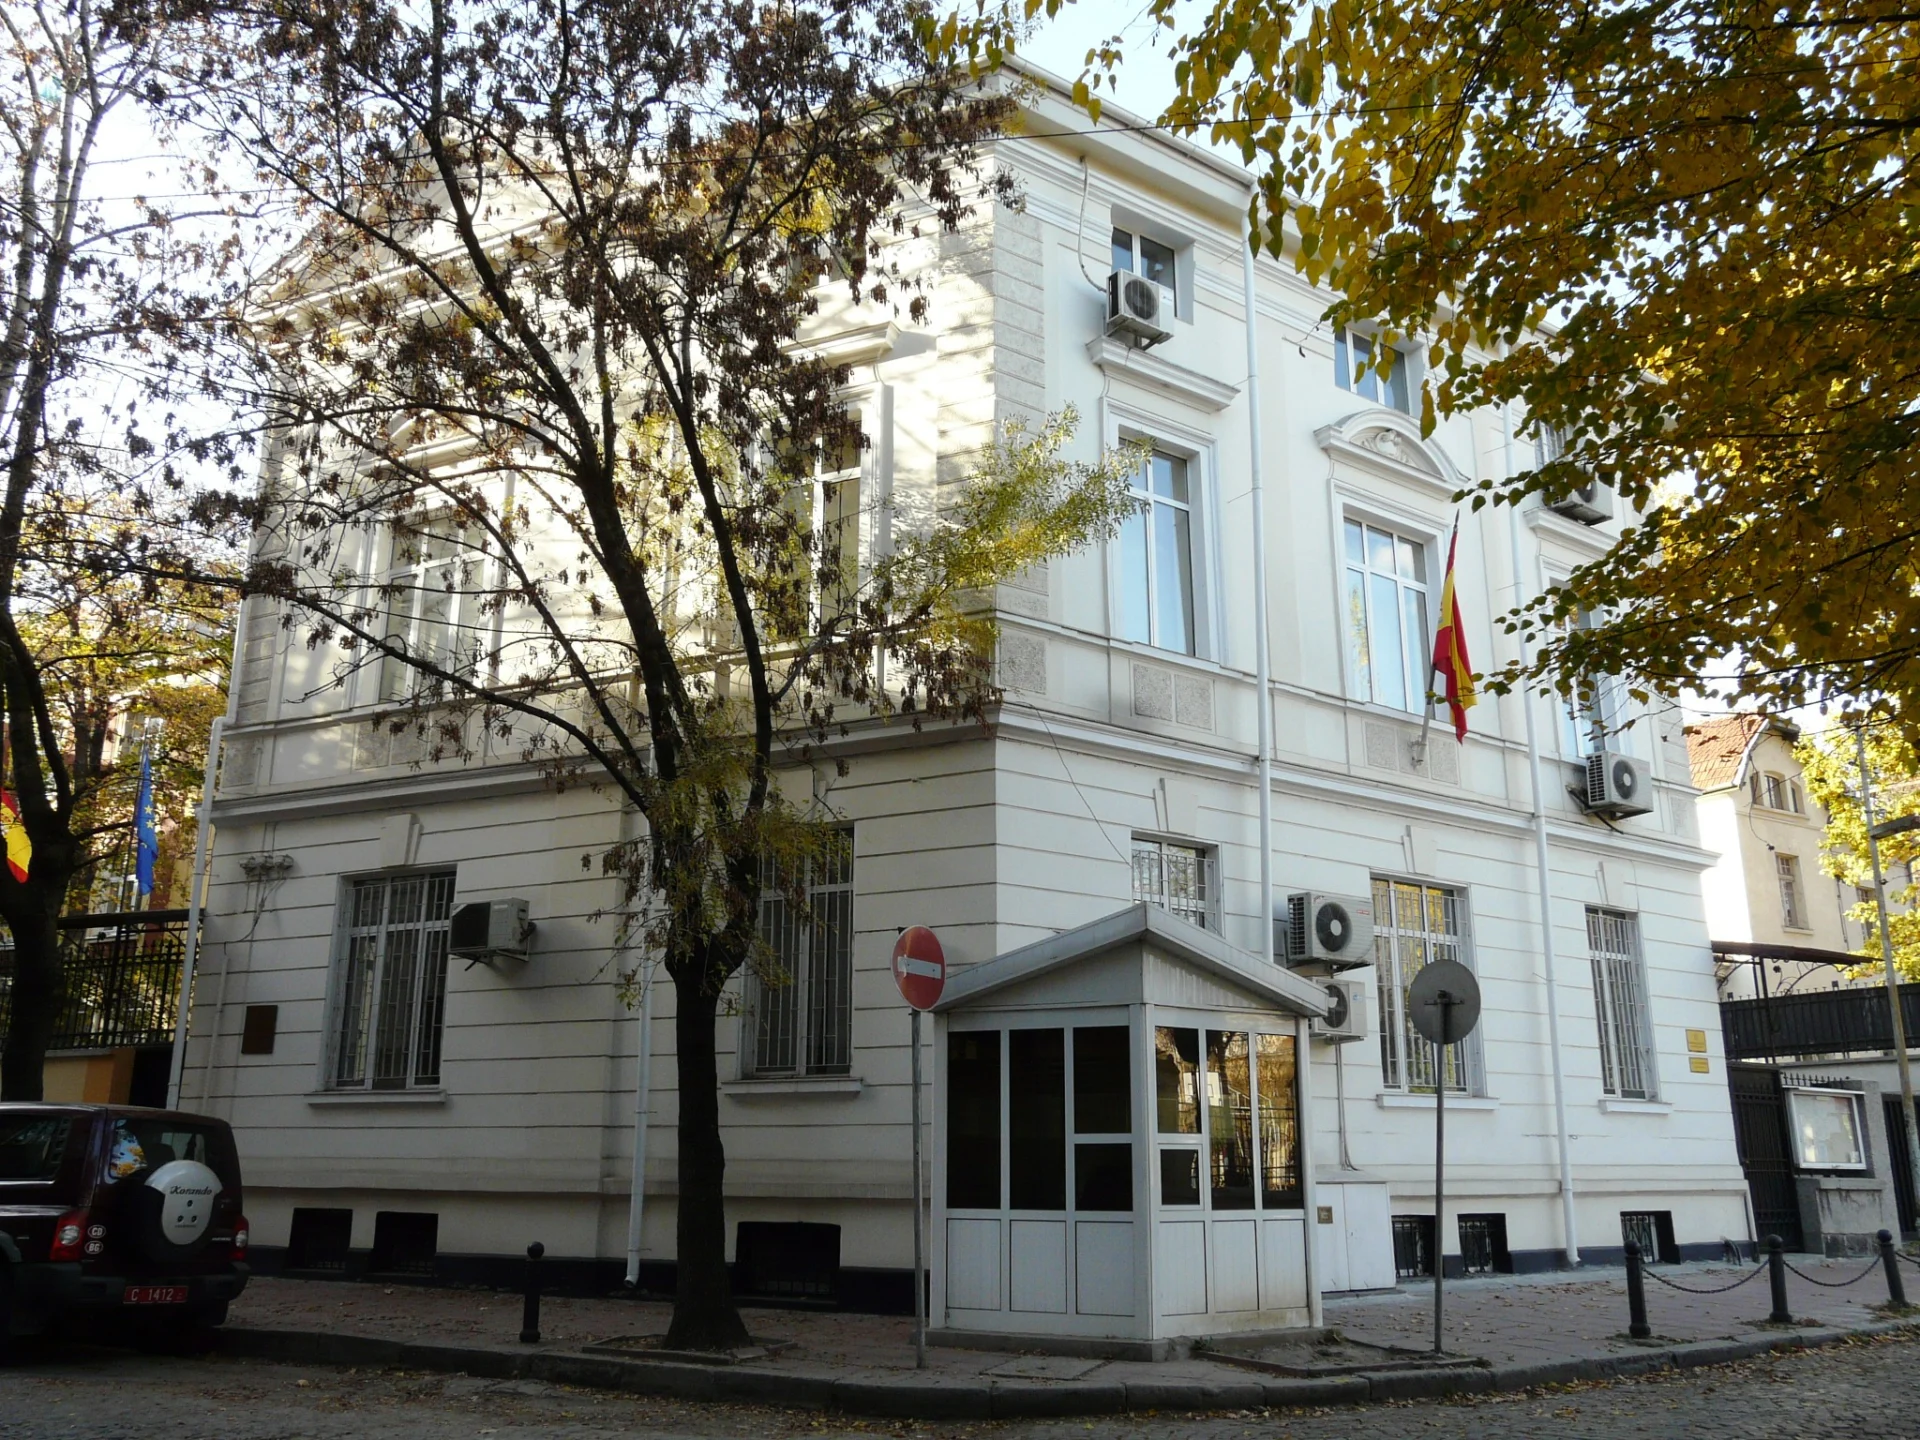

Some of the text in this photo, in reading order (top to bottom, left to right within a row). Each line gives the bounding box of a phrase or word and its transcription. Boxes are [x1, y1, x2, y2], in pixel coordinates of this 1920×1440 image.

[170, 1185, 213, 1196] Korando
[91, 1227, 103, 1236] CD
[88, 1243, 100, 1252] BG
[148, 1288, 174, 1301] 1412
